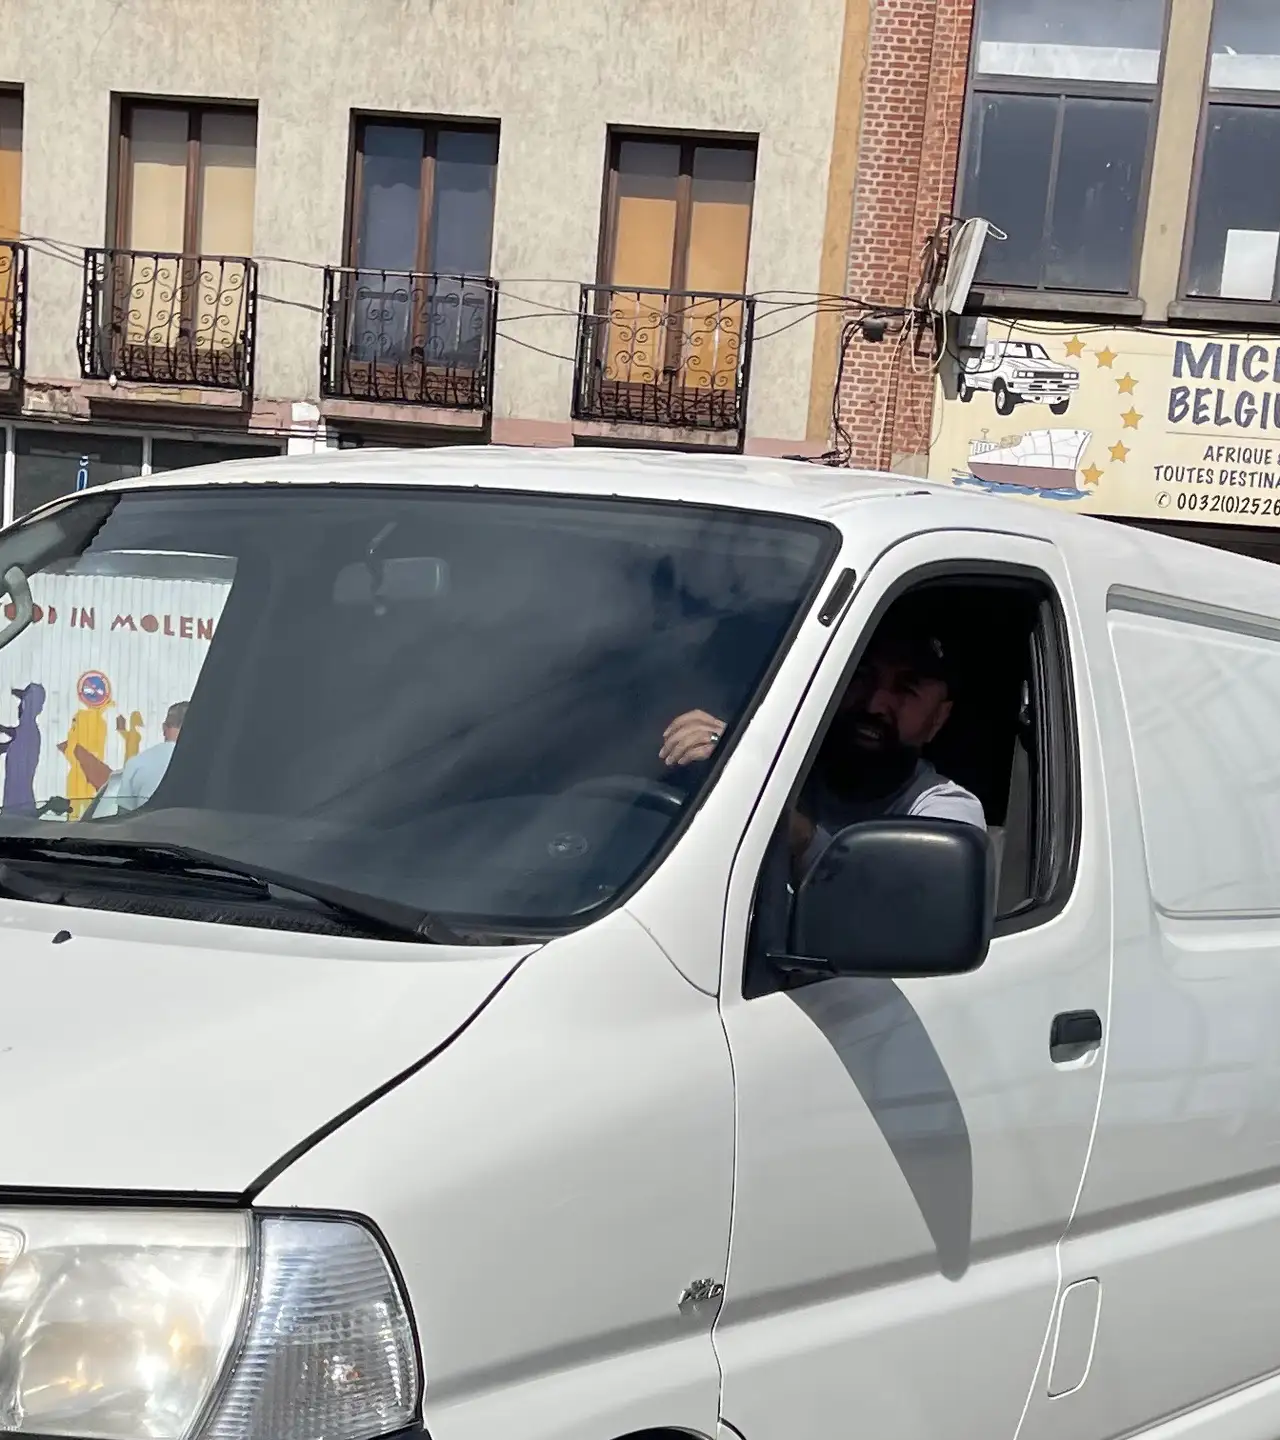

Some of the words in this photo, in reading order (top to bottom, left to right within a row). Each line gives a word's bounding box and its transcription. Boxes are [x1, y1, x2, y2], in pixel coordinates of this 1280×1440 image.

[1202, 445, 1273, 465] AFRIQUE
[1153, 464, 1215, 485] TOUTES
[70, 607, 95, 631] IN
[110, 613, 214, 641] MOLEN
